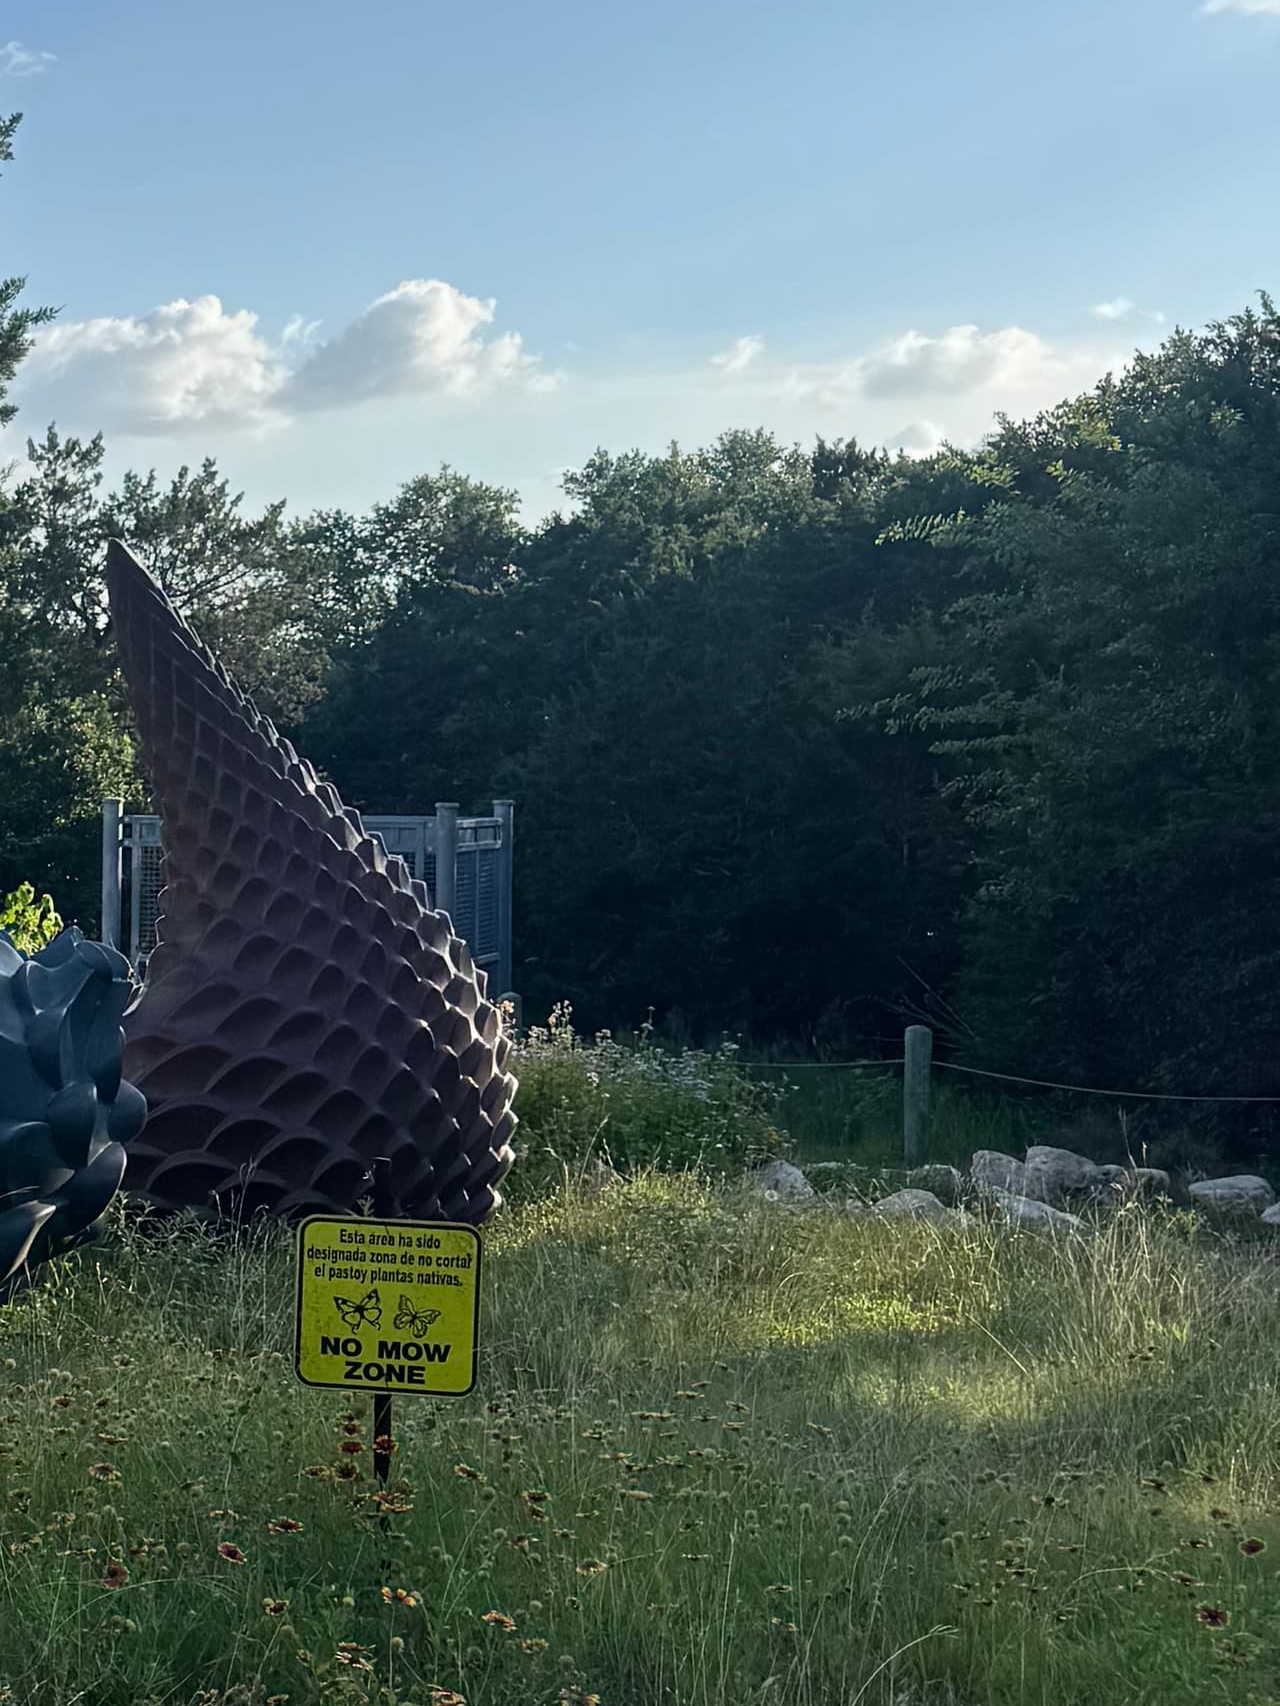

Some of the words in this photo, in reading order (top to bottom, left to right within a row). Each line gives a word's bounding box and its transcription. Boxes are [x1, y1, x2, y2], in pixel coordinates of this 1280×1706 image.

[340, 1229, 365, 1244] Esta
[399, 1233, 413, 1248] ha
[416, 1234, 440, 1249] sido
[307, 1245, 366, 1263] designada
[369, 1252, 397, 1264] zona
[400, 1252, 415, 1265] de
[418, 1255, 433, 1266] no
[436, 1253, 471, 1269] cortar
[314, 1263, 326, 1277] el
[371, 1267, 414, 1284] plantas
[417, 1271, 463, 1286] nativas.
[321, 1336, 362, 1357] NO
[378, 1340, 451, 1363] MOW
[344, 1360, 426, 1384] ZONE
